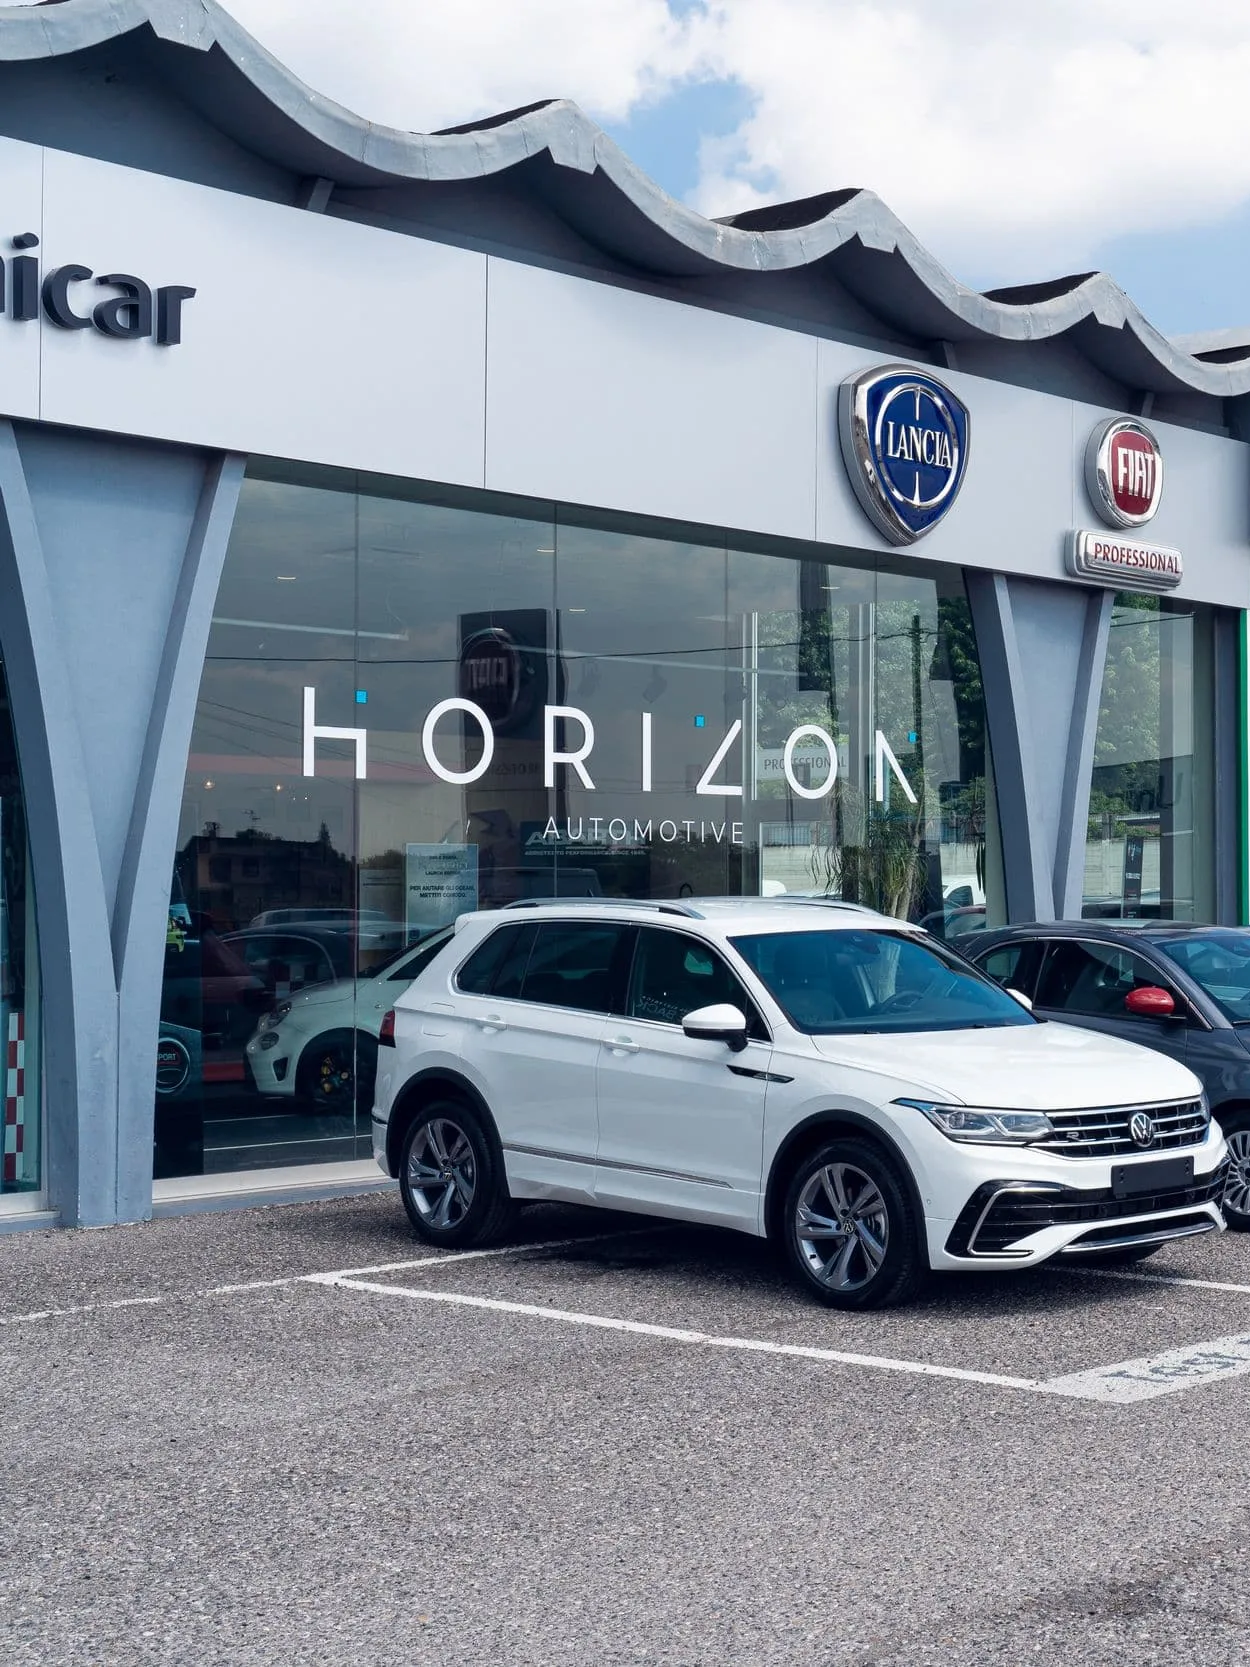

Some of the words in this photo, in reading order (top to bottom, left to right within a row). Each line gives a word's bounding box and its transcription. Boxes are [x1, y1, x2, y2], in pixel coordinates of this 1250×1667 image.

[0, 232, 197, 346] icar
[887, 421, 953, 469] LANCIA
[1117, 446, 1154, 500] FIAT
[1094, 542, 1180, 574] PROFESSIONAL
[764, 756, 847, 770] PROESSIONL
[543, 816, 744, 844] AUTOMOTIVE
[157, 1053, 176, 1061] PORT
